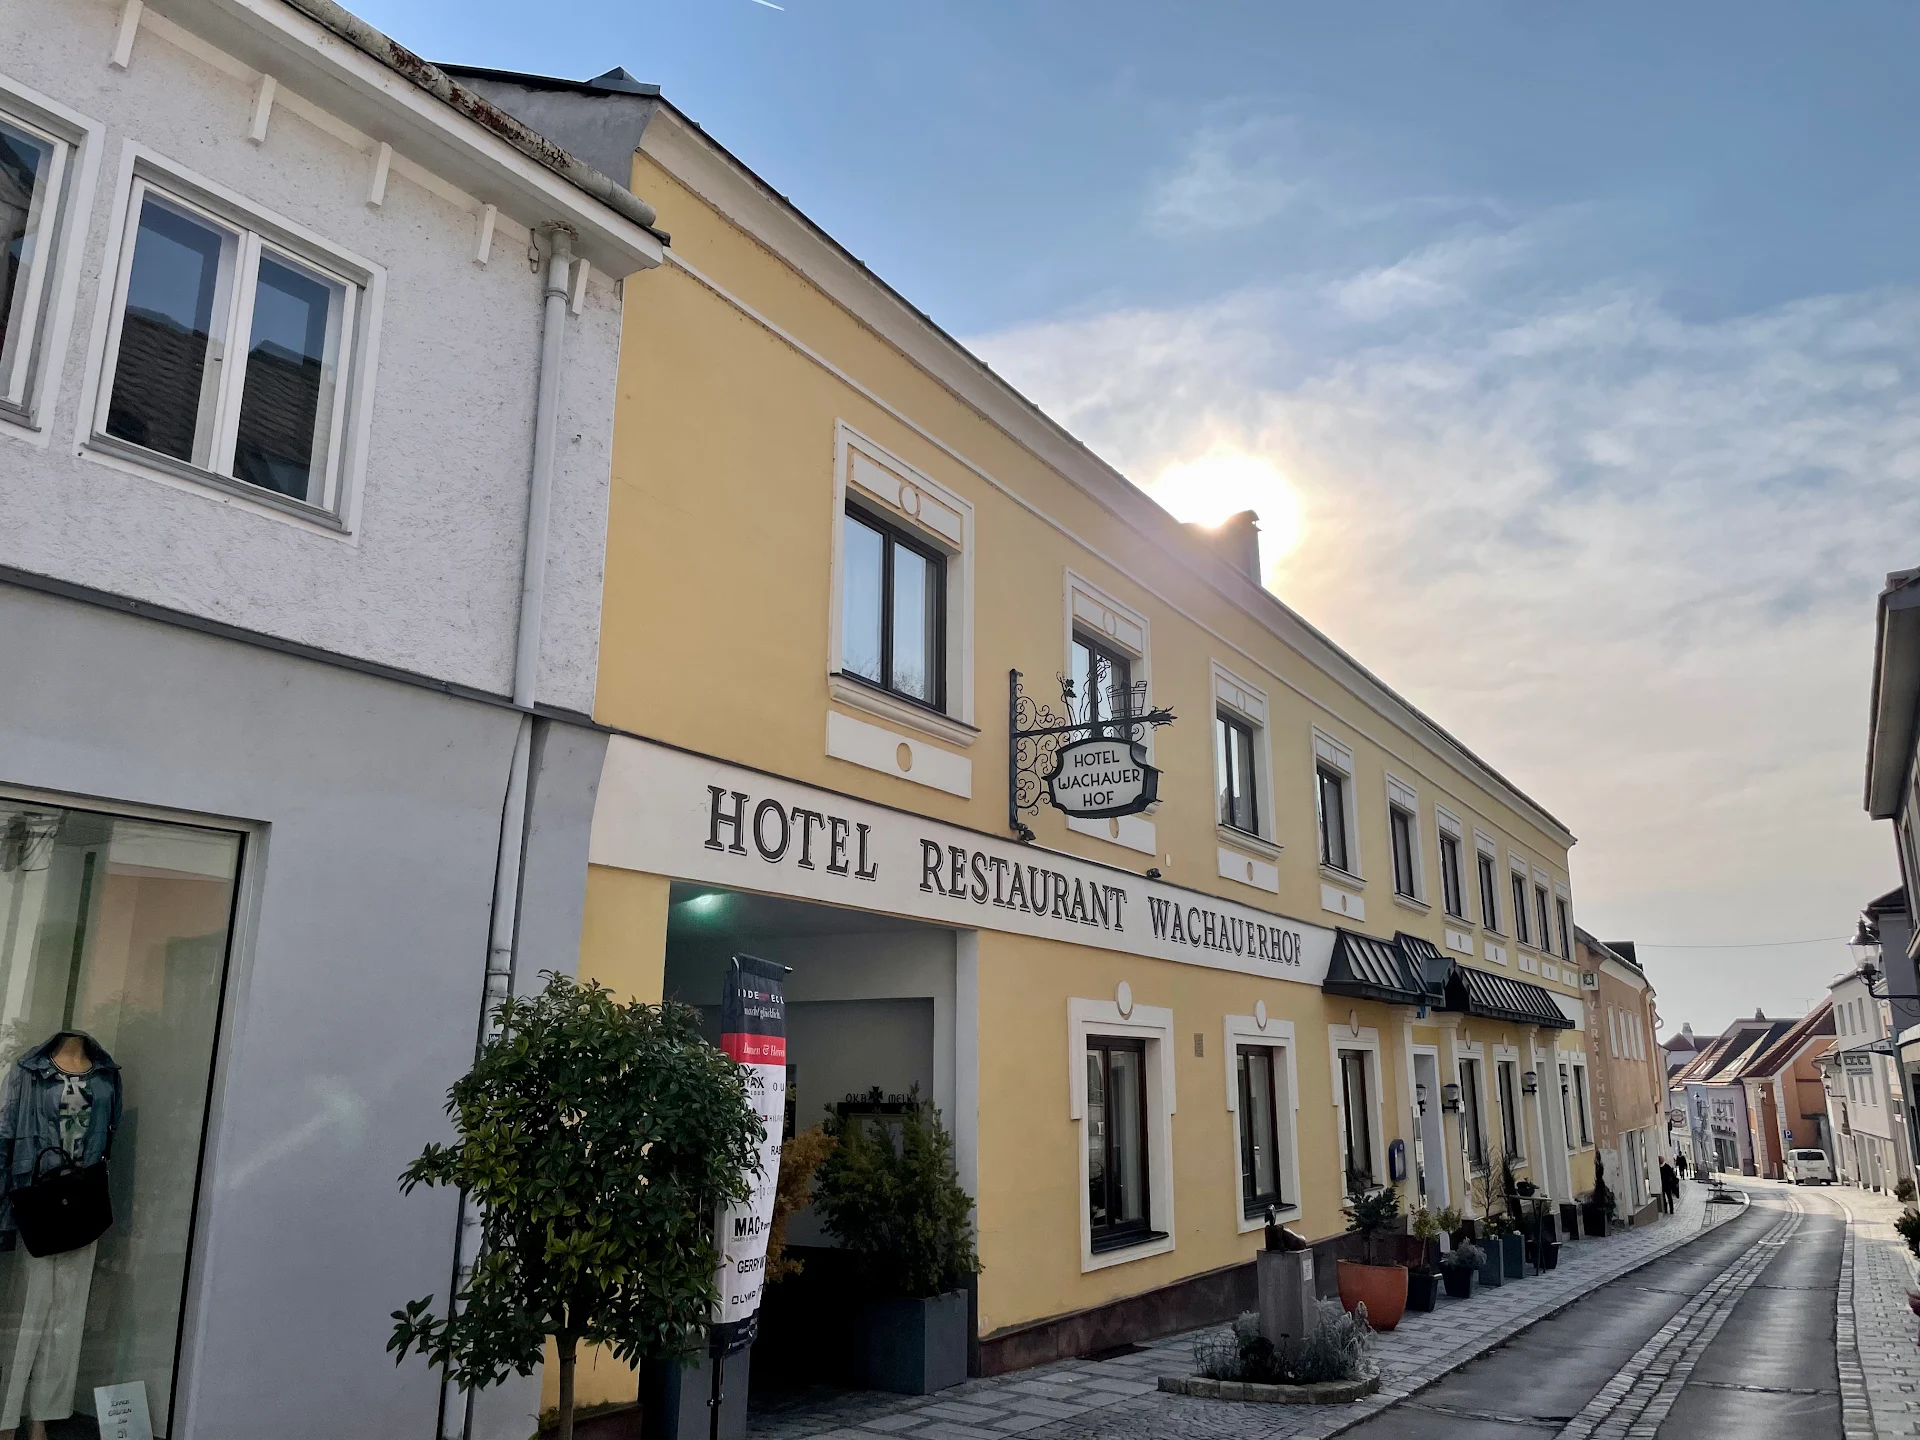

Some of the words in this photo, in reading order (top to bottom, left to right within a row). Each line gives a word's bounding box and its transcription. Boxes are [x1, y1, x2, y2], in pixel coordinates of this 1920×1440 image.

[1074, 750, 1120, 768] HOTEL
[1057, 769, 1141, 790] WACHAUER
[1083, 791, 1114, 807] HOF
[704, 784, 878, 882] HOTEL
[919, 838, 1128, 933] RESTAURANT
[1146, 896, 1302, 967] WACHAUERHOF
[762, 1045, 770, 1056] &
[734, 1216, 761, 1237] MAC
